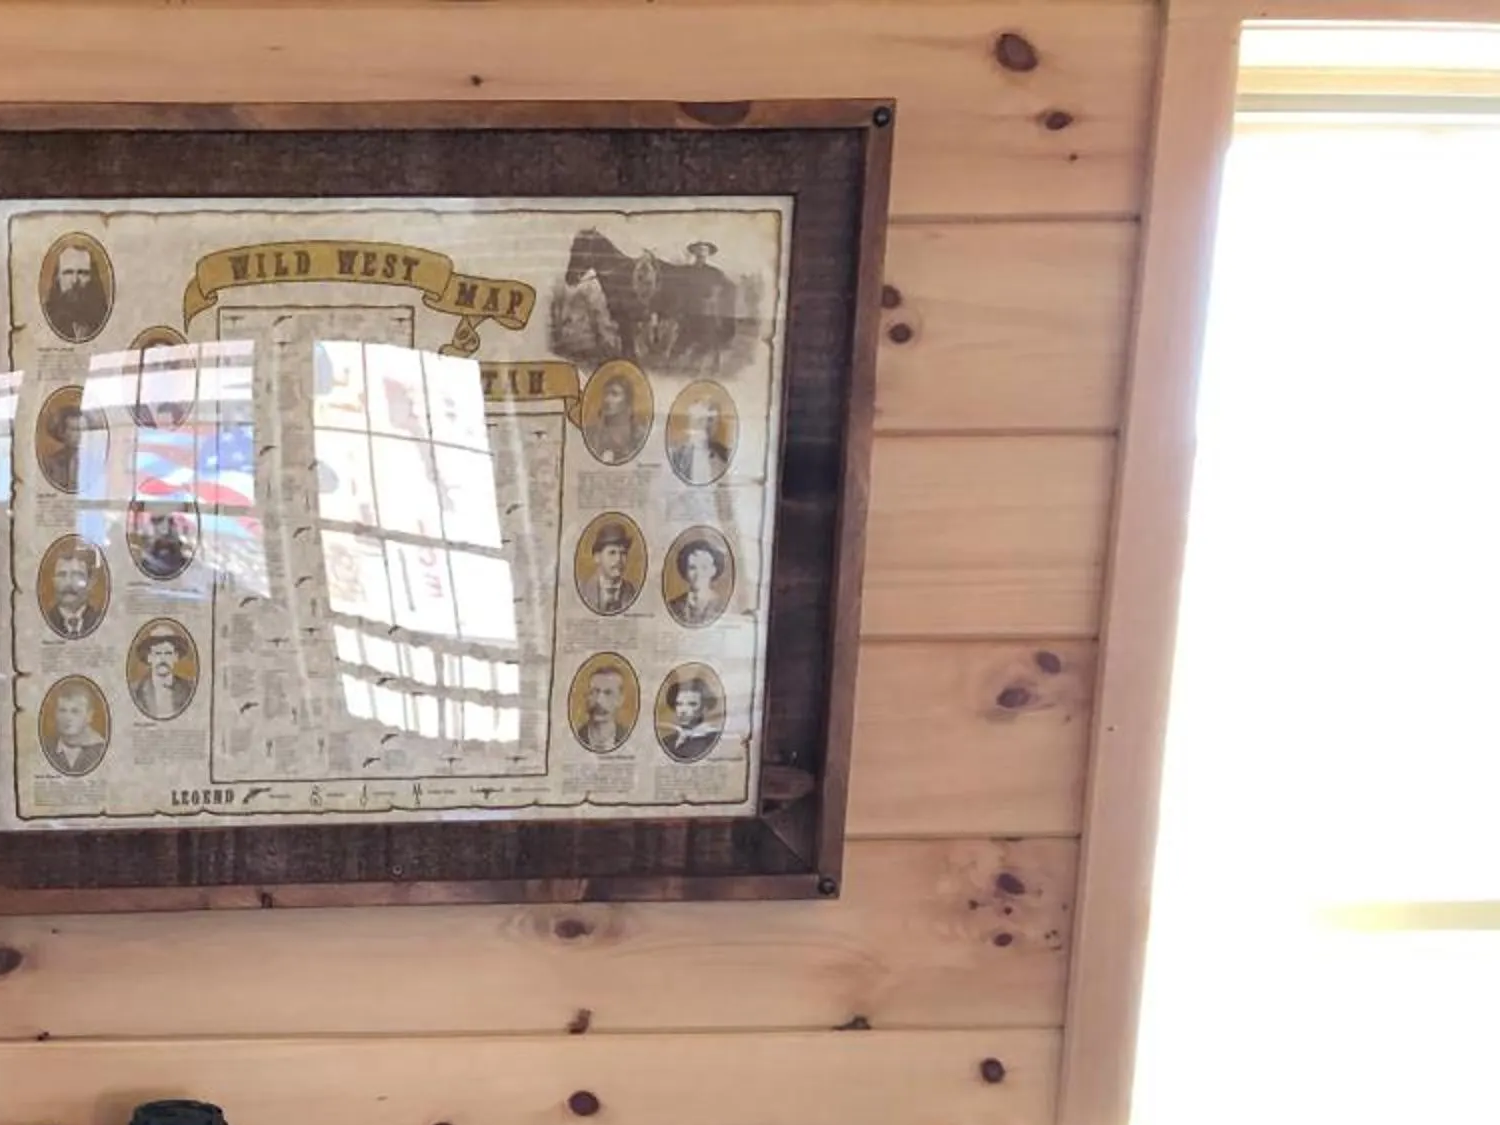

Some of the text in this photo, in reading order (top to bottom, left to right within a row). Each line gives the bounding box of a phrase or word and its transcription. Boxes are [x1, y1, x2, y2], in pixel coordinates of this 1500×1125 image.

[228, 249, 421, 282] WILD WEST
[455, 281, 524, 315] MAP
[171, 788, 235, 806] LEGEND
